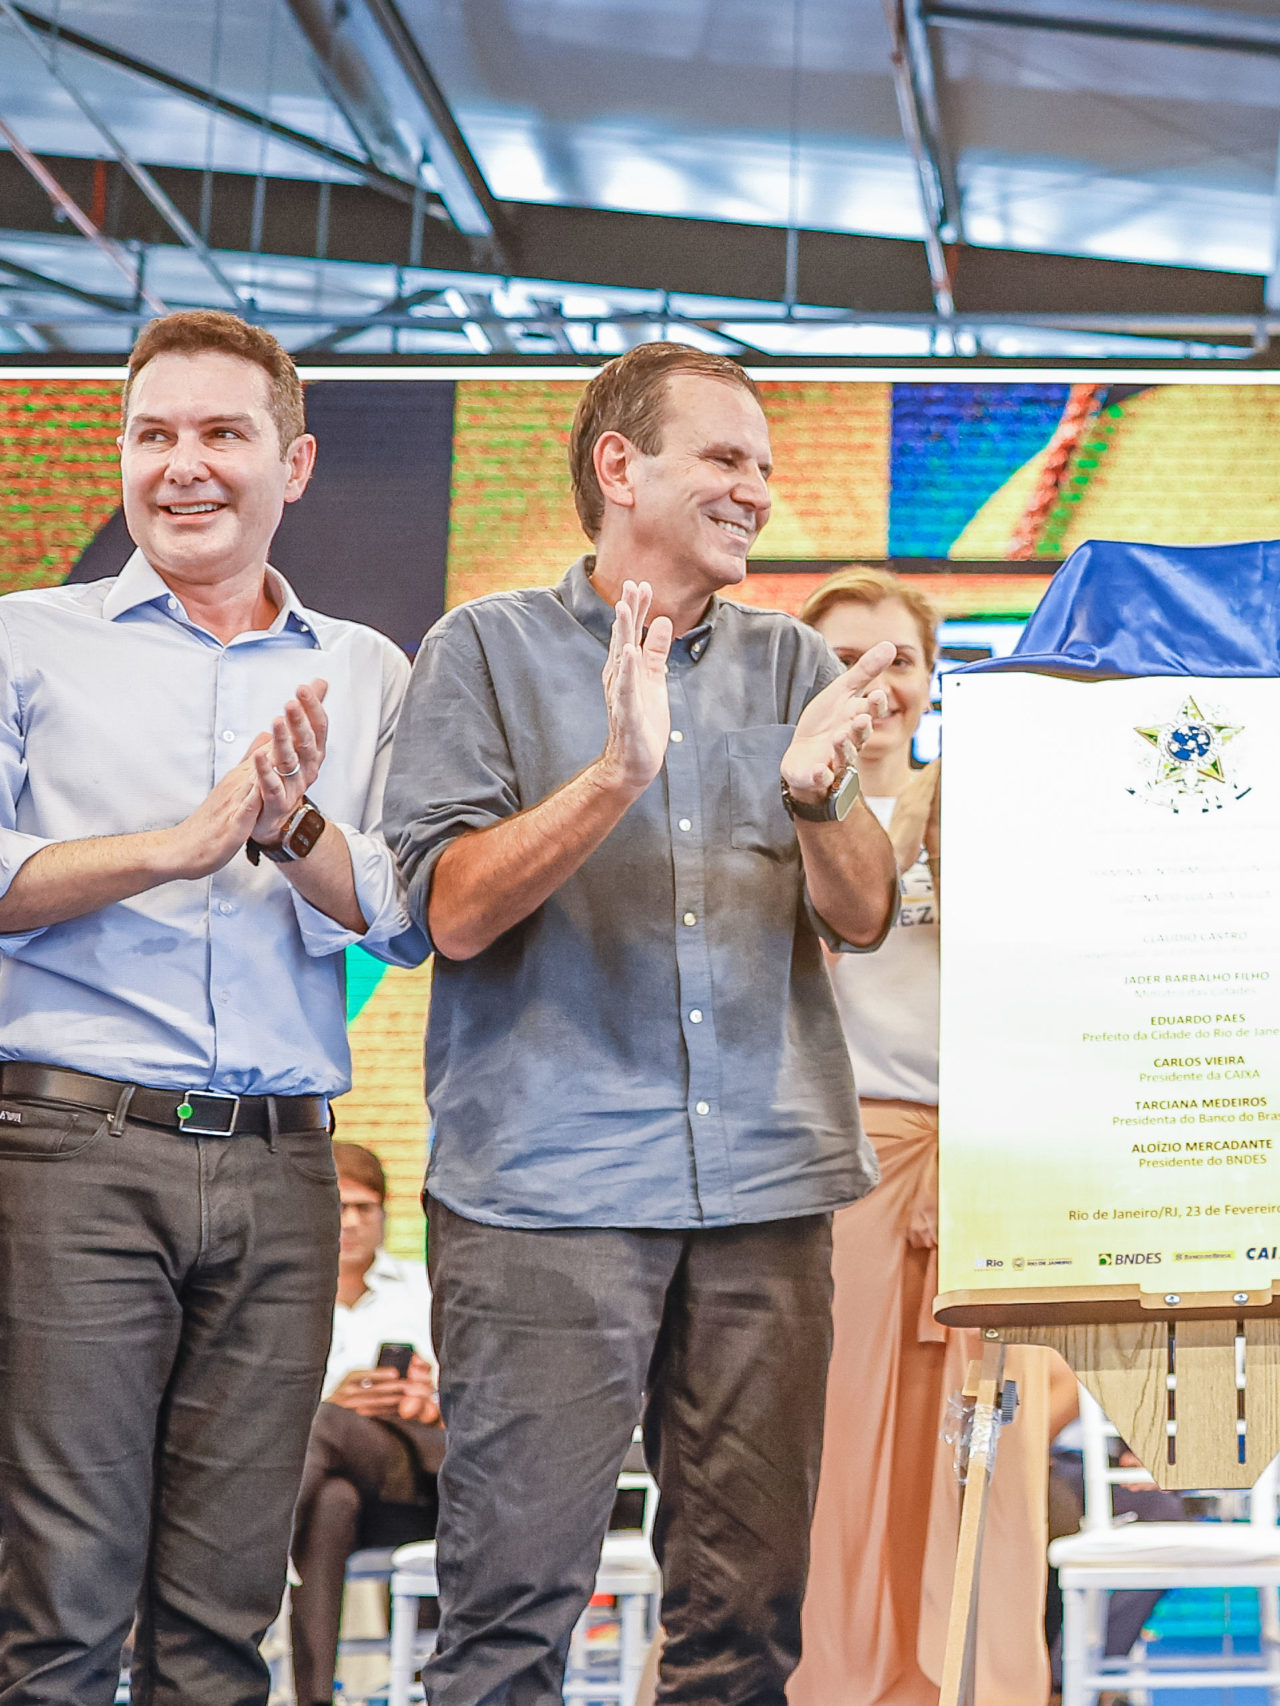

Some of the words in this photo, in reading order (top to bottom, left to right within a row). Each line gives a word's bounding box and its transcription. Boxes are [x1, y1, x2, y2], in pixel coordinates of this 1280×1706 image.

[1123, 974, 1161, 985] JADER
[1164, 973, 1231, 983] BARBALHO
[1233, 971, 1270, 981] FILHO
[1150, 1015, 1210, 1026] EDUARDO
[1215, 1014, 1247, 1024] PAES
[1082, 1032, 1130, 1043] Prefeito
[1133, 1030, 1149, 1041] da
[1151, 1029, 1192, 1040] Cidade
[1195, 1029, 1210, 1039] do
[1213, 1028, 1233, 1038] Rio
[1236, 1027, 1251, 1037] de
[1153, 1057, 1202, 1068] CARLOS
[1205, 1055, 1245, 1066] VIEIRA
[1138, 1072, 1204, 1083] Presidente
[1206, 1071, 1222, 1081] da
[1225, 1069, 1261, 1080] CAIXA
[1134, 1099, 1199, 1110] TARCIANA
[1202, 1097, 1268, 1109] MEDEIROS
[1112, 1115, 1177, 1127] Presidenta
[1179, 1114, 1196, 1124] do
[1199, 1113, 1235, 1124] Banco
[1238, 1112, 1254, 1122] do
[1131, 1140, 1183, 1153] ALOÍZIO
[1186, 1139, 1273, 1152] MERCADANTE
[1138, 1157, 1204, 1168] Presidente
[1206, 1156, 1223, 1166] do
[1226, 1154, 1267, 1165] BNDES
[1068, 1210, 1089, 1221] Rio
[1092, 1209, 1110, 1220] de
[1112, 1206, 1182, 1220] Janeiro/RJ,
[1185, 1206, 1202, 1217] 23
[1204, 1205, 1221, 1217] de
[985, 1258, 1004, 1268] Rio
[1114, 1252, 1162, 1265] BNDES
